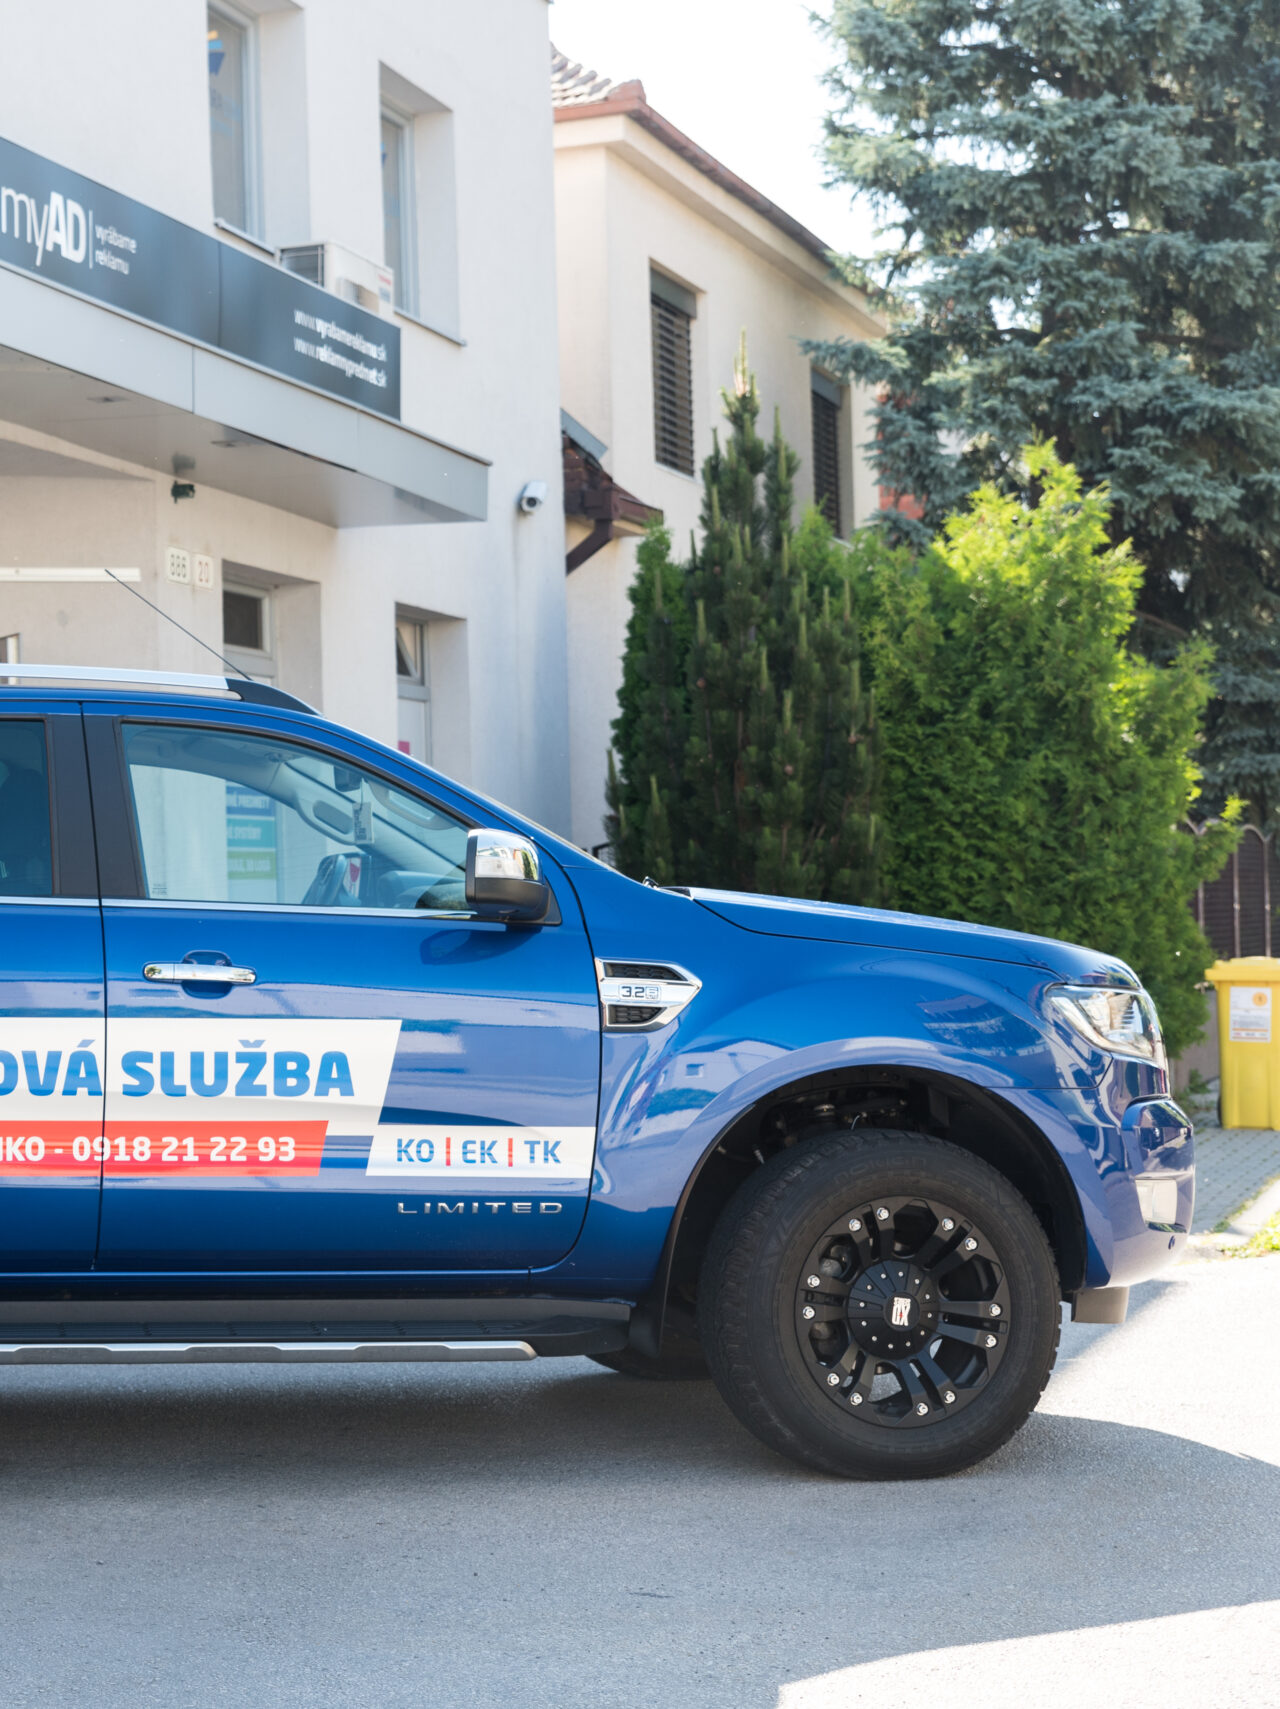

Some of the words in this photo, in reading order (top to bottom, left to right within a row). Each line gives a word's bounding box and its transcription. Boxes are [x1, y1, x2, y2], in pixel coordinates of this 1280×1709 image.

[1, 186, 87, 267] myAD
[95, 249, 130, 275] reklamu
[121, 1039, 355, 1098] SLUŽBA
[72, 1136, 152, 1163] 0918
[161, 1136, 199, 1162] 21
[208, 1136, 248, 1162] 22
[257, 1136, 297, 1162] 93
[396, 1138, 434, 1163] KO
[462, 1139, 498, 1164] EK
[524, 1140, 562, 1164] TK
[397, 1202, 563, 1214] LIMITED
